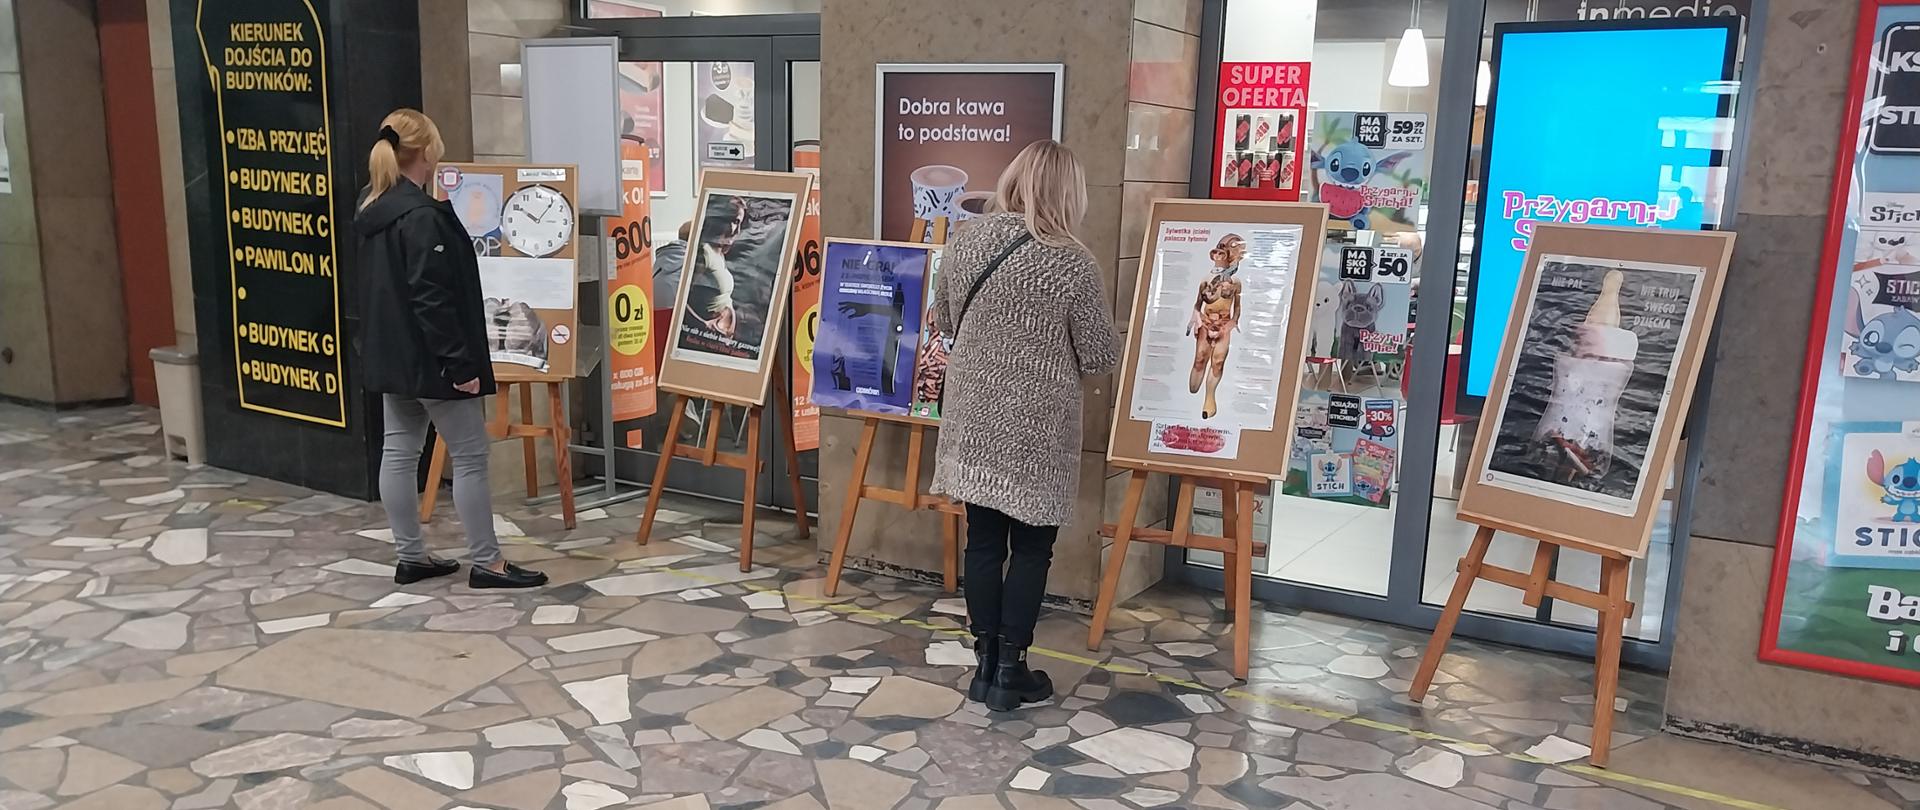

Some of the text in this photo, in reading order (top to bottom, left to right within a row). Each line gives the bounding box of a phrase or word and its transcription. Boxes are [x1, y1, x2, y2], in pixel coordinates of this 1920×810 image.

[230, 22, 304, 42] KIERUNEK
[224, 44, 313, 67] DOJŚCIA DO
[226, 68, 313, 92] BUDYNKÓW:
[1231, 65, 1301, 85] SUPER
[1222, 87, 1306, 107] OFERTA
[899, 97, 1005, 116] Dobra kawa
[1360, 116, 1381, 126] MA
[1392, 120, 1414, 135] 59
[898, 123, 1011, 144] to podstawa!
[1359, 126, 1381, 135] SKO
[237, 127, 327, 160] IZBA PRZYJĘĆ
[1359, 134, 1380, 143] TKA
[240, 168, 327, 197] BUDYNEK B
[241, 207, 329, 238] BUDYNEK C
[563, 218, 568, 226] 3
[558, 231, 563, 239] 4
[547, 239, 553, 248] 5
[1347, 250, 1367, 259] MA
[1380, 249, 1386, 257] 2
[245, 246, 332, 277] PAWILON K
[1346, 259, 1367, 267] SKO
[1377, 258, 1408, 277] 50
[1346, 267, 1366, 275] TKI
[1551, 277, 1583, 289] NIE PAL
[1641, 286, 1680, 301] NIE TRUJ
[615, 293, 643, 323] 0 zł
[1644, 302, 1676, 314] SWEGO
[1633, 316, 1671, 330] DZIECKA
[248, 322, 335, 356] BUDYNEK G
[251, 359, 337, 394] BUDYNEK D
[1330, 401, 1359, 409] KSIĄŻKI
[1366, 410, 1393, 421] -30%
